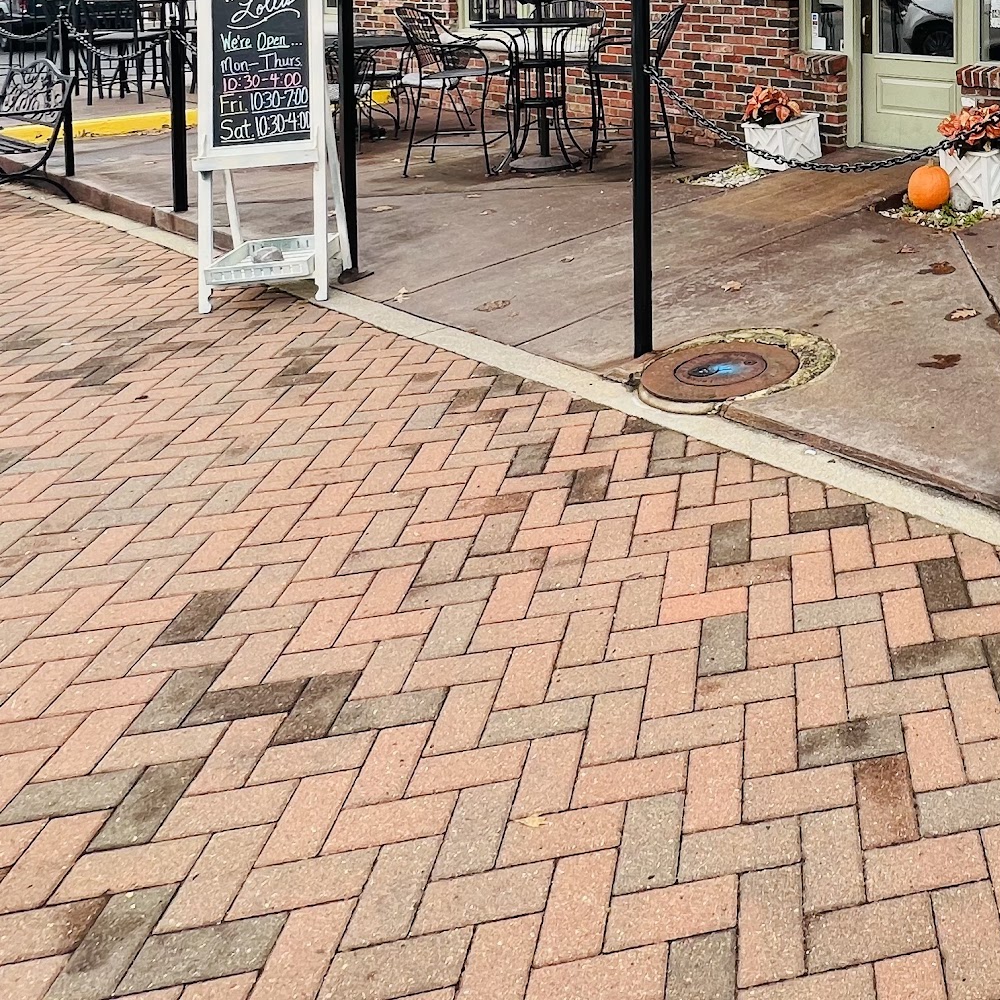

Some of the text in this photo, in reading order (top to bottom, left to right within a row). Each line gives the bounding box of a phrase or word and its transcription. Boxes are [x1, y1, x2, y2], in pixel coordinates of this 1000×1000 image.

[220, 31, 252, 51] We're
[219, 93, 248, 114] Fri.
[220, 118, 255, 140] Sat.
